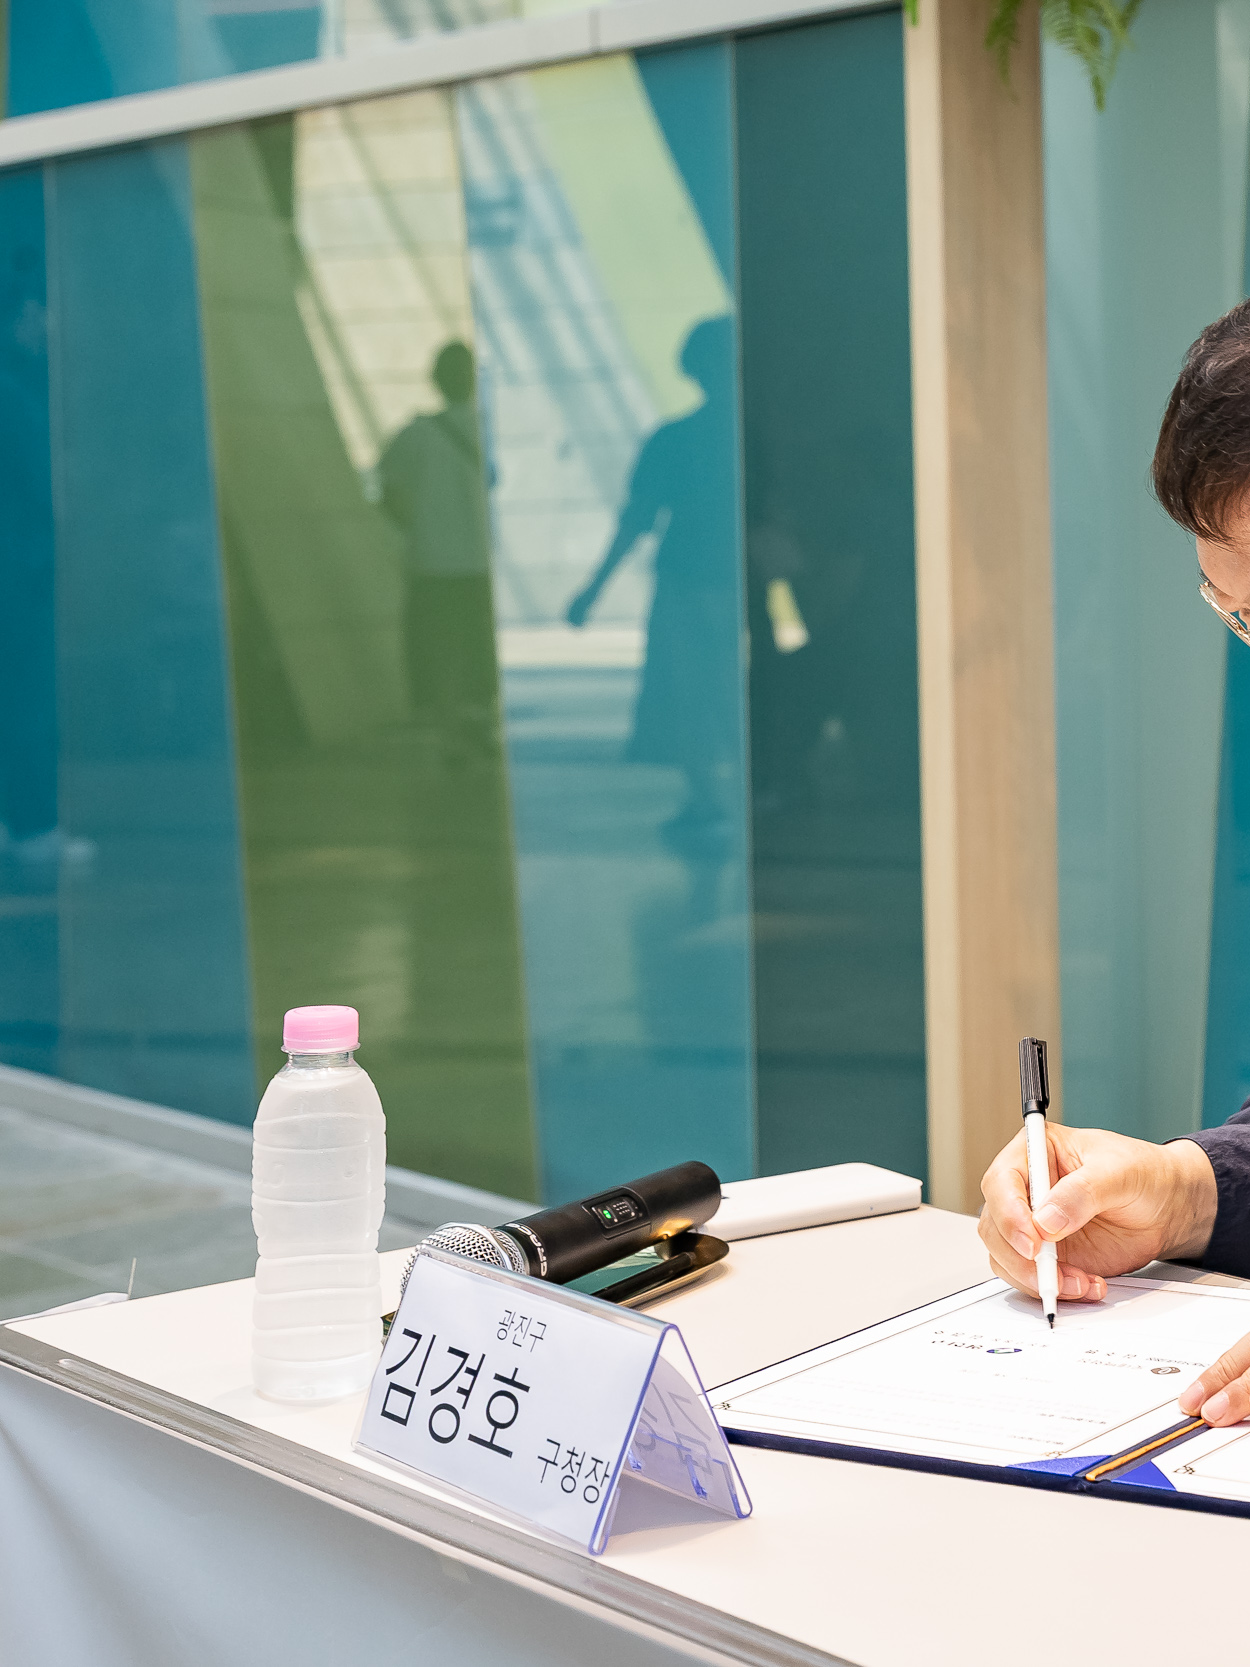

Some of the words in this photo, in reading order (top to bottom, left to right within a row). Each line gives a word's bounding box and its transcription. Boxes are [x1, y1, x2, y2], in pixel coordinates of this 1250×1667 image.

[496, 1309, 548, 1353] 광진구
[380, 1328, 531, 1459] 김경호
[537, 1438, 610, 1504] 구청장
